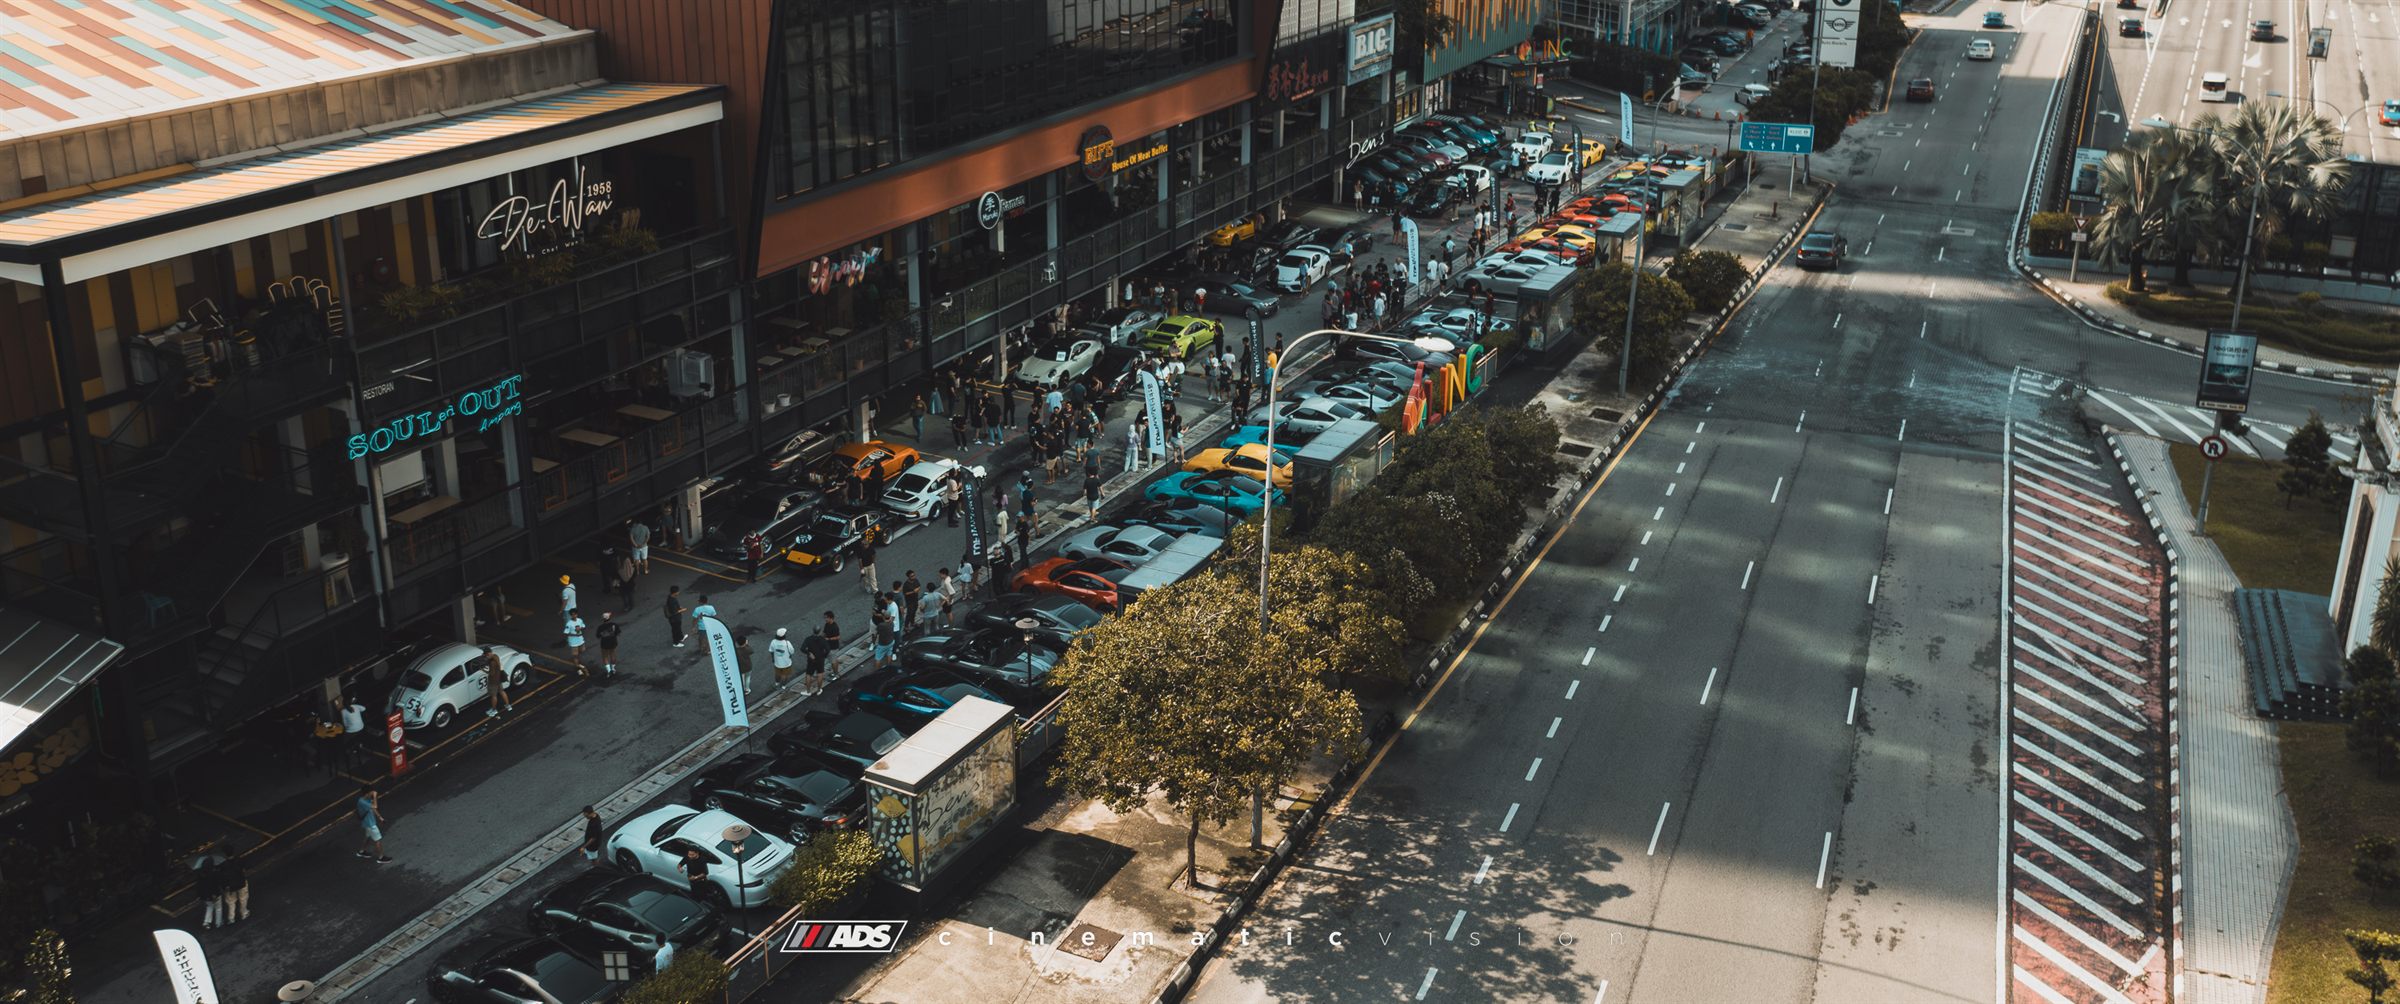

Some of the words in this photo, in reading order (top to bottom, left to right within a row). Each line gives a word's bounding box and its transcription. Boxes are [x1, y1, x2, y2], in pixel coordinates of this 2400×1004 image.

[1111, 159, 1129, 173] House
[586, 181, 612, 198] 1958
[362, 381, 395, 400] RESTORAN
[348, 411, 441, 461] SOUL
[459, 374, 522, 416] OUT
[478, 401, 522, 433] Ampang
[478, 676, 488, 690] 53
[406, 698, 421, 712] 53
